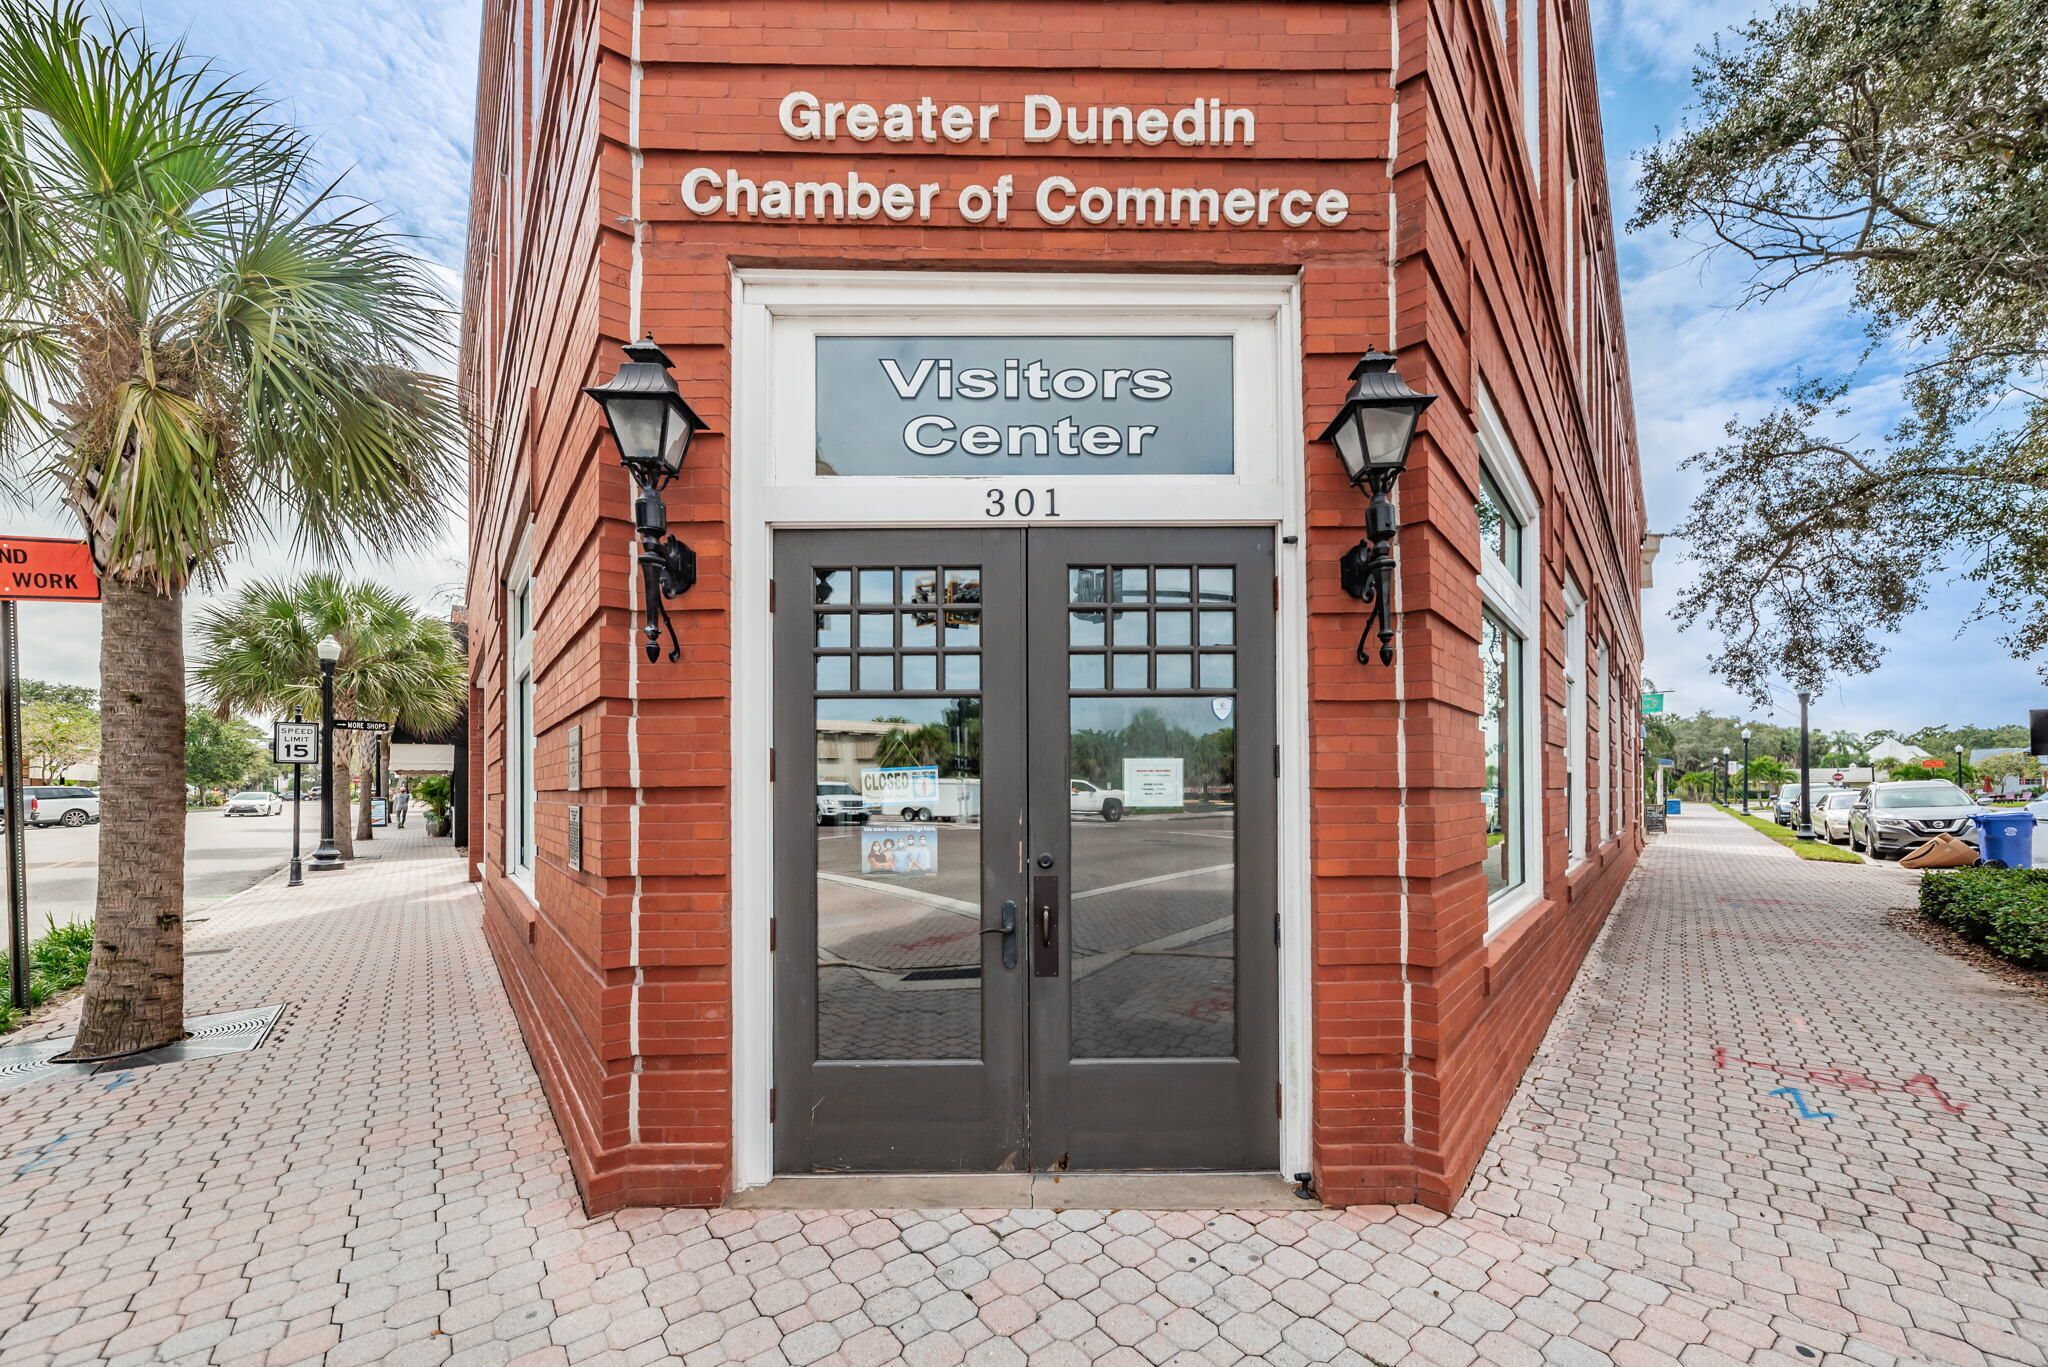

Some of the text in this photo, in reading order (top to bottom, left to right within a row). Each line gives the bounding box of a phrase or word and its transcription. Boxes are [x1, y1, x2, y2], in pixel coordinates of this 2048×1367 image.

[779, 91, 1255, 147] Greater Dunedin
[681, 168, 1349, 227] Chamber of Commerce
[879, 358, 1173, 400] Visitors
[903, 415, 1158, 456] Center
[985, 488, 1060, 518] 301
[12, 572, 78, 590] WORK
[281, 727, 314, 735] SPEED
[347, 721, 364, 729] MORE
[284, 744, 309, 758] 15
[864, 772, 909, 791] CLOSED
